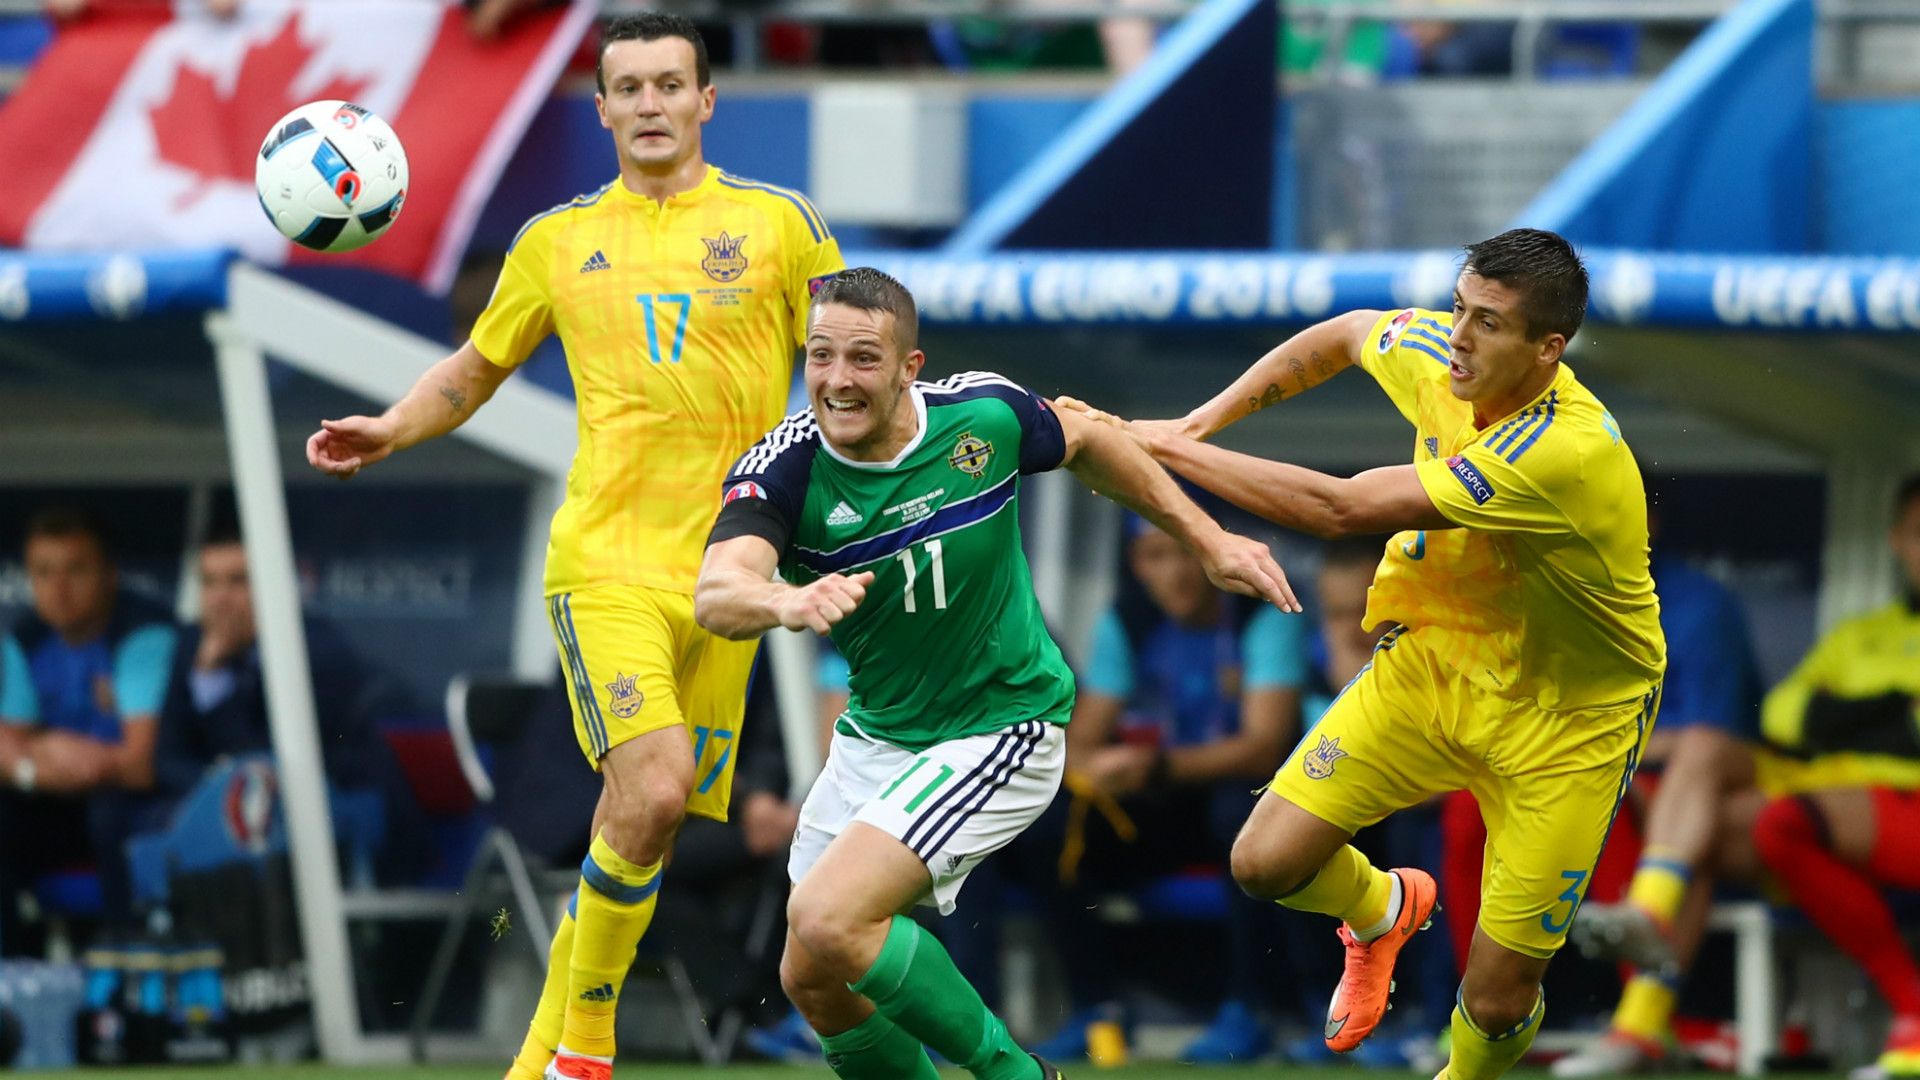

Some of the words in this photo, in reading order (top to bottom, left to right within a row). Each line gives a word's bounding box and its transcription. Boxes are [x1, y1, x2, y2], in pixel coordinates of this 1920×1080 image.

[580, 262, 612, 274] adidas
[1029, 260, 1180, 321] EURO
[1189, 260, 1334, 319] 2016
[1711, 262, 1858, 326] UEFA
[636, 294, 691, 363] 17
[1455, 462, 1491, 501] RESPECT
[827, 514, 863, 526] adidas
[896, 539, 947, 613] 11
[694, 725, 734, 795] 17
[879, 756, 956, 815] 11
[1541, 870, 1588, 934] 3
